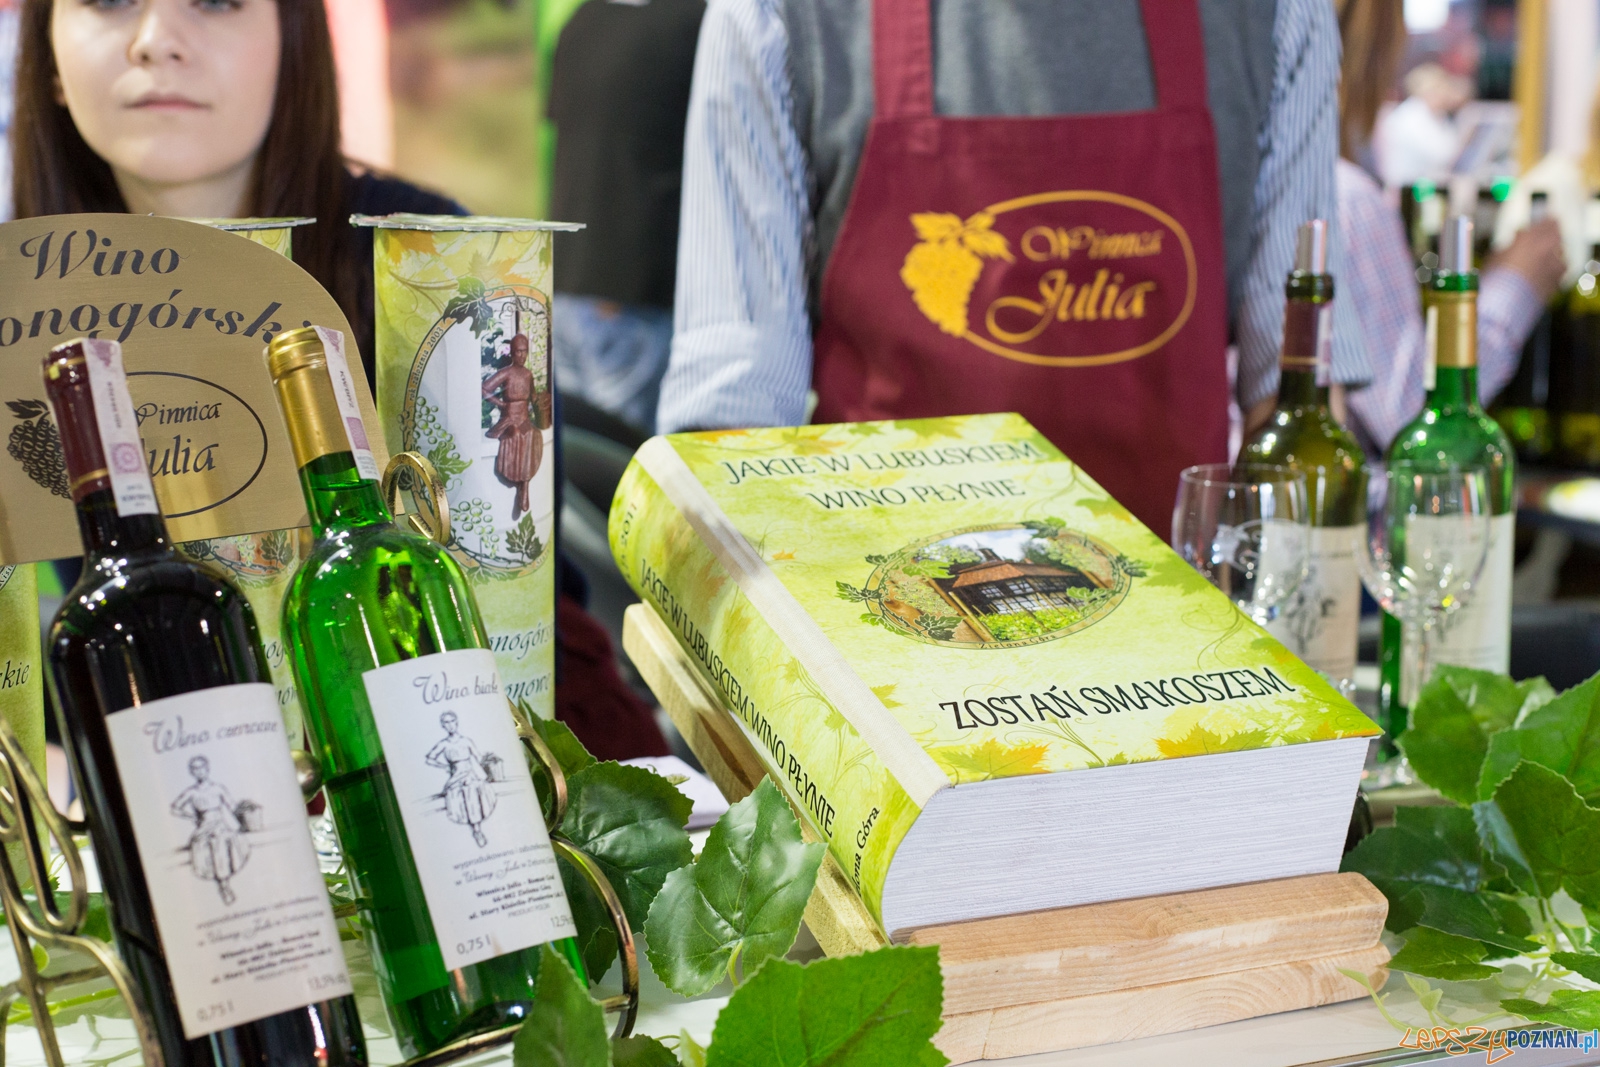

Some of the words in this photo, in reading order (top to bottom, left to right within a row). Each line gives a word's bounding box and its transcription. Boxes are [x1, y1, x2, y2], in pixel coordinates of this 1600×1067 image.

[20, 229, 190, 279] Wino
[0, 289, 313, 346] onogórsk
[985, 266, 1158, 344] Julia
[141, 434, 219, 477] ulia
[722, 456, 816, 485] JAKIE
[816, 454, 850, 472] W
[854, 442, 1045, 471] LUBUSKIEM
[806, 487, 907, 510] WINO
[909, 478, 1027, 503] PŁYNIE
[0, 660, 30, 690] kie
[412, 670, 470, 705] Wino
[641, 558, 669, 614] JAKIE
[669, 595, 683, 629] W
[682, 613, 749, 722] LUBUSKIEM
[750, 702, 786, 769] WINO
[788, 753, 836, 838] PŁYNIE
[939, 684, 1089, 730] ZOSTAŃ
[1080, 666, 1296, 716] SMAKOSZEM
[143, 714, 211, 755] Wino
[857, 807, 880, 849] Góra
[456, 937, 484, 955] 0,75
